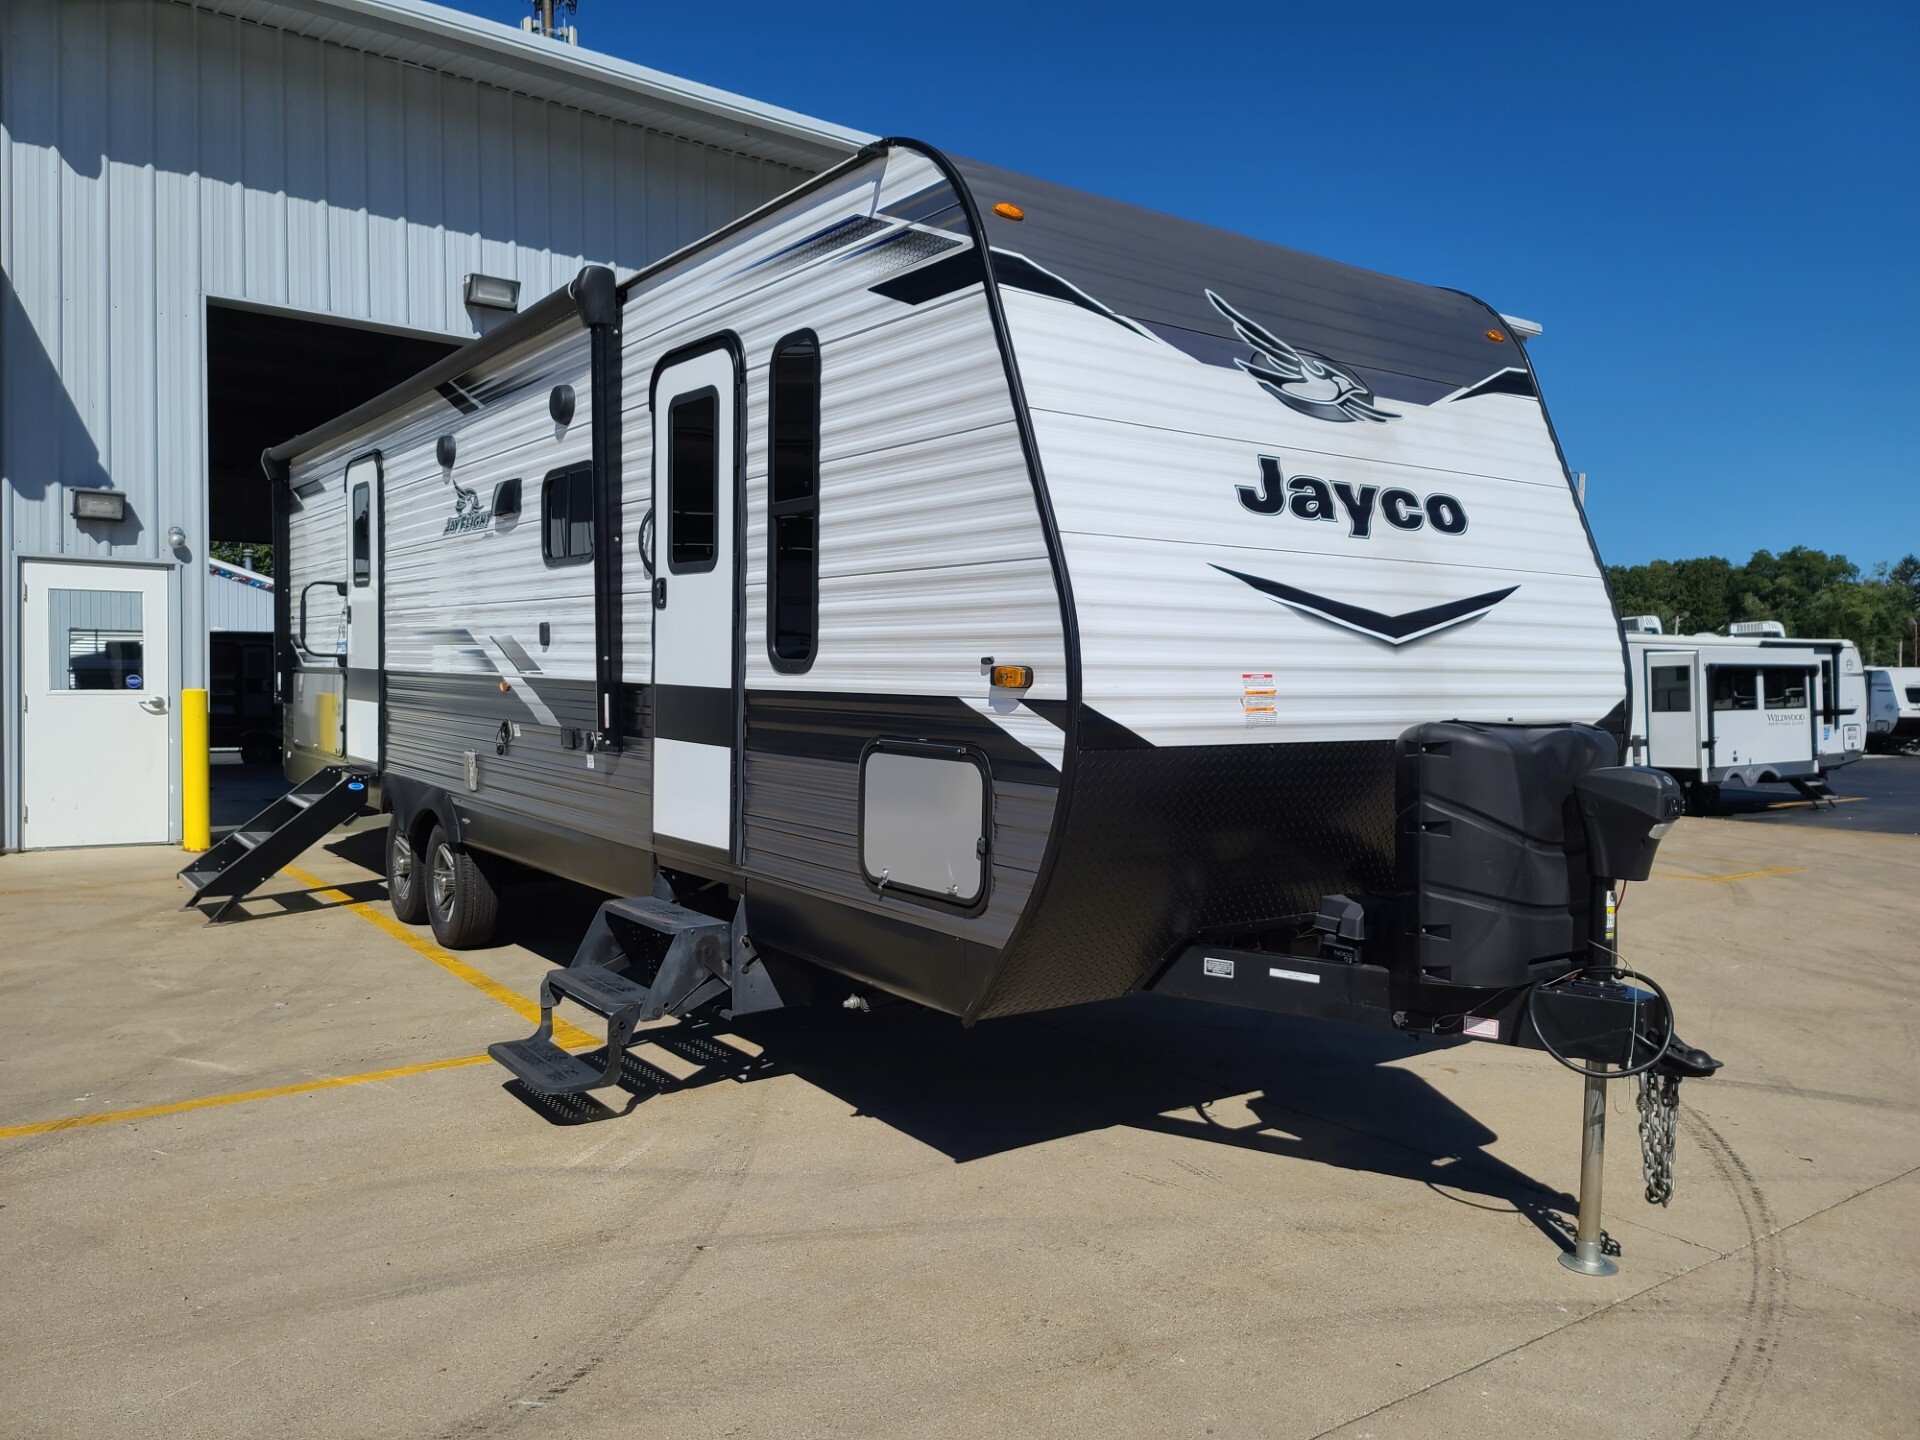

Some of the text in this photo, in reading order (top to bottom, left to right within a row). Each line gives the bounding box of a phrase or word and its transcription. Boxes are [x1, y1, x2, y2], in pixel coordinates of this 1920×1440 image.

[443, 511, 492, 535] JAY FLIGHT
[1234, 454, 1469, 539] Jayco
